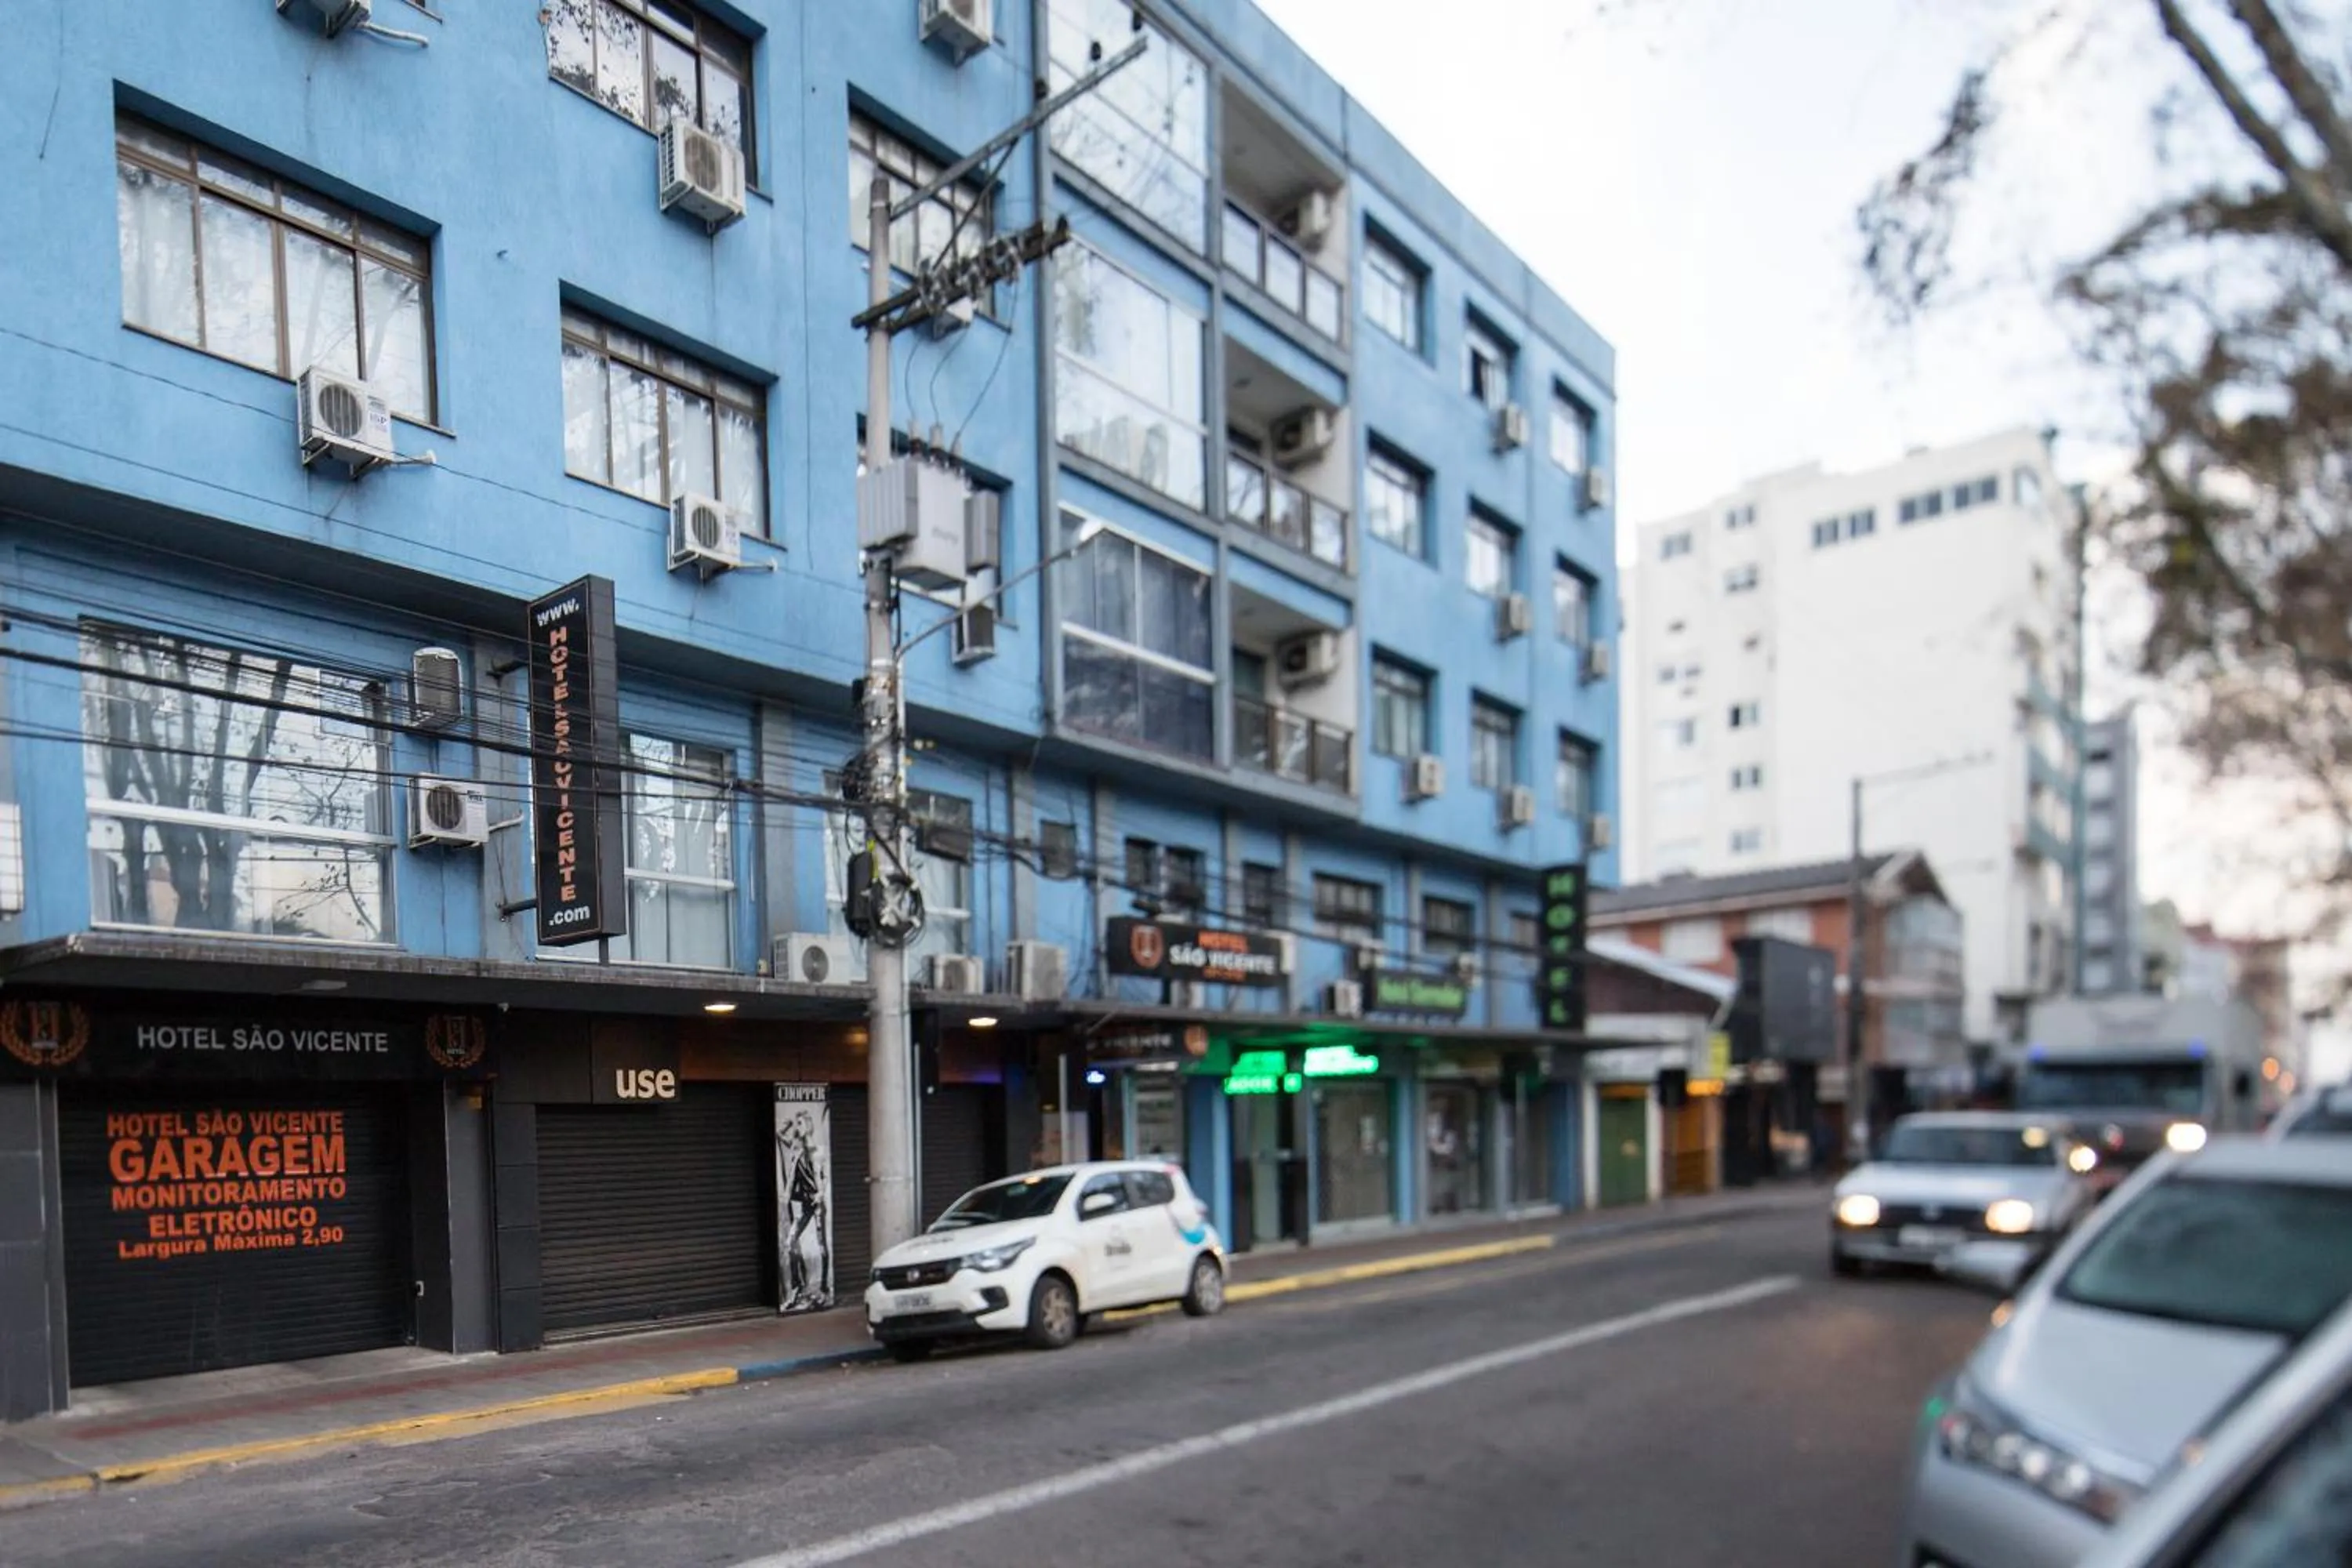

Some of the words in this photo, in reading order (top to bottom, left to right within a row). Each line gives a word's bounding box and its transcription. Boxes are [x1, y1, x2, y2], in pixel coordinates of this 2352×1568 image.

[537, 597, 579, 626] www.
[549, 905, 590, 926] .com
[1207, 950, 1276, 976] VICENTE
[137, 1025, 226, 1050] HOTEL
[232, 1024, 285, 1051] SÃO
[291, 1029, 389, 1052] VICENTE
[615, 1069, 676, 1099] use
[107, 1112, 190, 1137] HOTEL
[196, 1109, 244, 1136] SÃO
[249, 1111, 344, 1134] VICENTE
[109, 1134, 347, 1182] GARAGEM
[111, 1176, 347, 1210] MONITORAMENTO
[148, 1204, 318, 1238] ELETRÔNICO
[118, 1237, 208, 1261] Largura
[301, 1226, 343, 1247] 2,90
